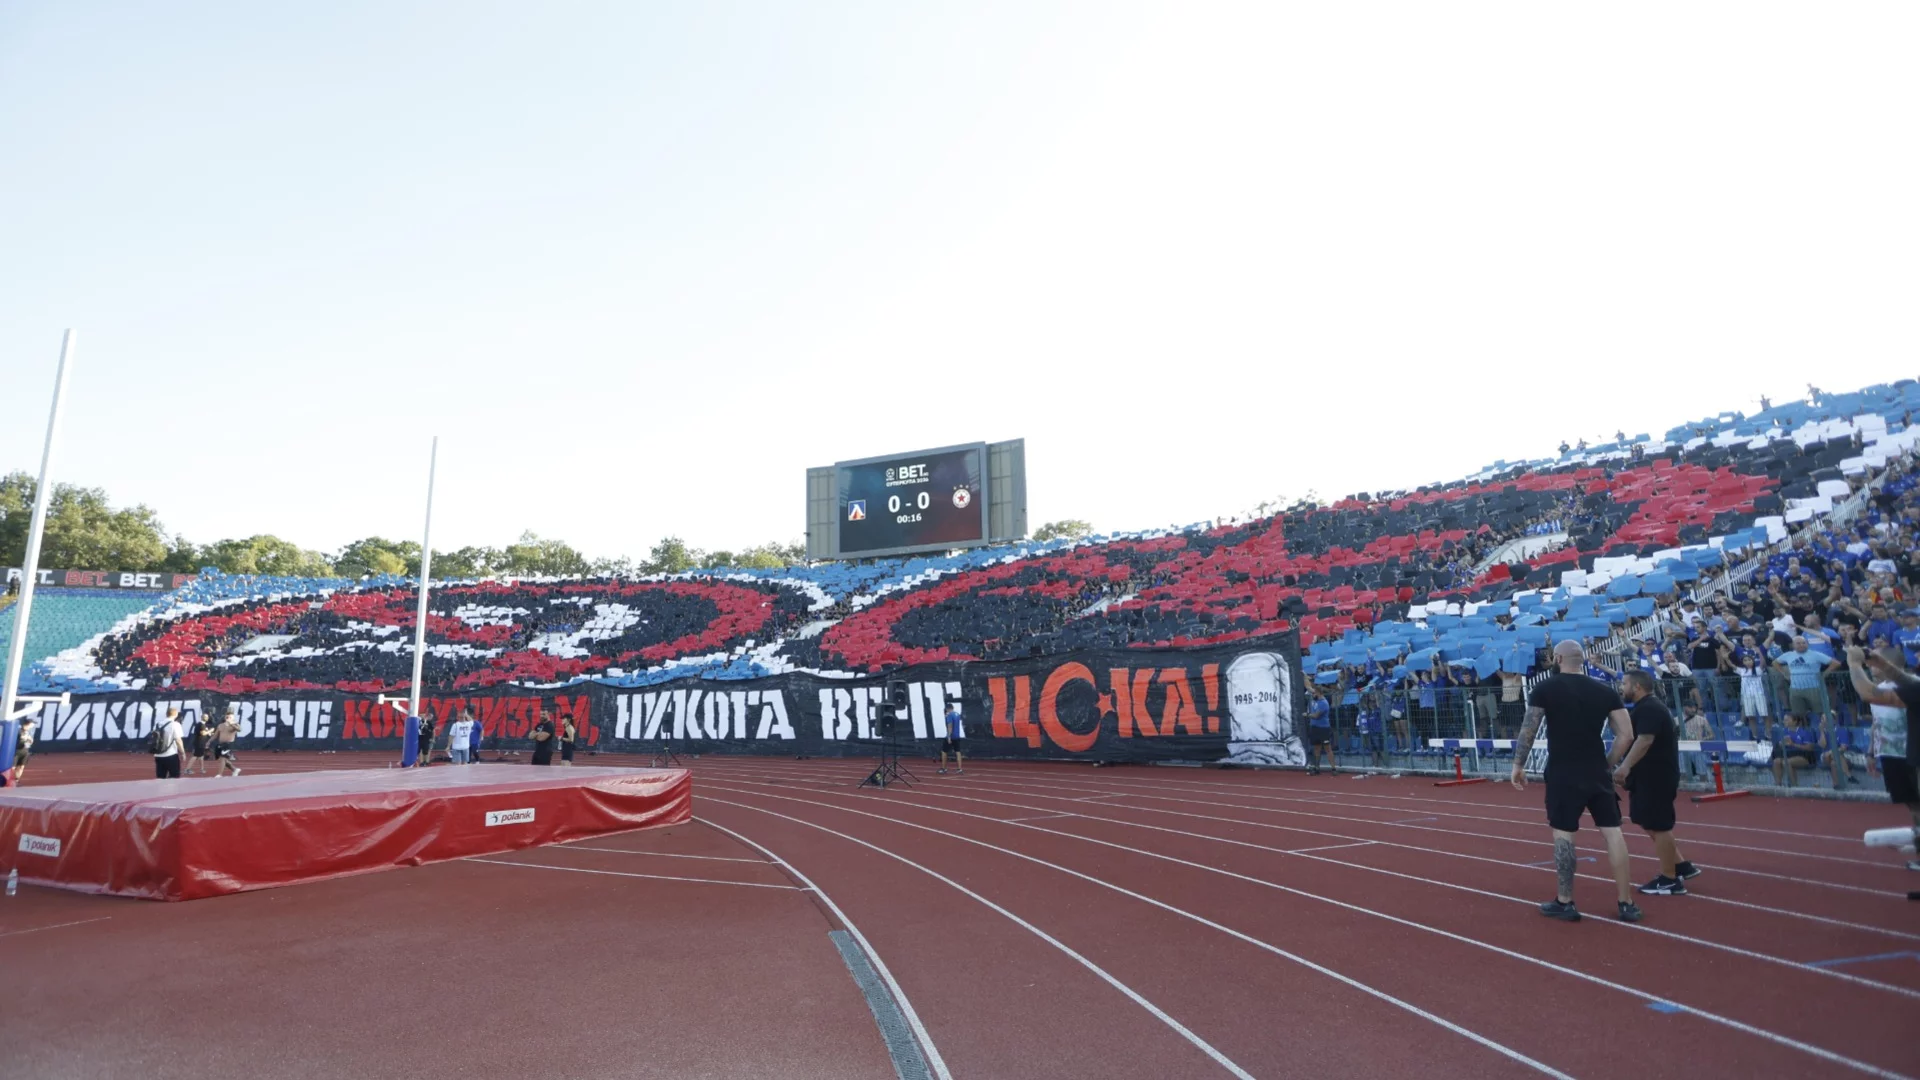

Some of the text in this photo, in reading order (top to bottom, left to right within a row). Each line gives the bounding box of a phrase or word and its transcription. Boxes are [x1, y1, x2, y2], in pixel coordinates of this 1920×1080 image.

[888, 495, 900, 513] 0
[917, 491, 930, 509] 0
[896, 513, 922, 524] 00:16
[6, 568, 52, 585] BT
[24, 700, 203, 741] НИКОГА
[227, 700, 333, 739] ВЕЧЕ
[615, 689, 796, 740] НИКОГА
[818, 681, 966, 740] ВЕЧЕ
[500, 811, 531, 823] polanik
[31, 840, 57, 852] polanik
